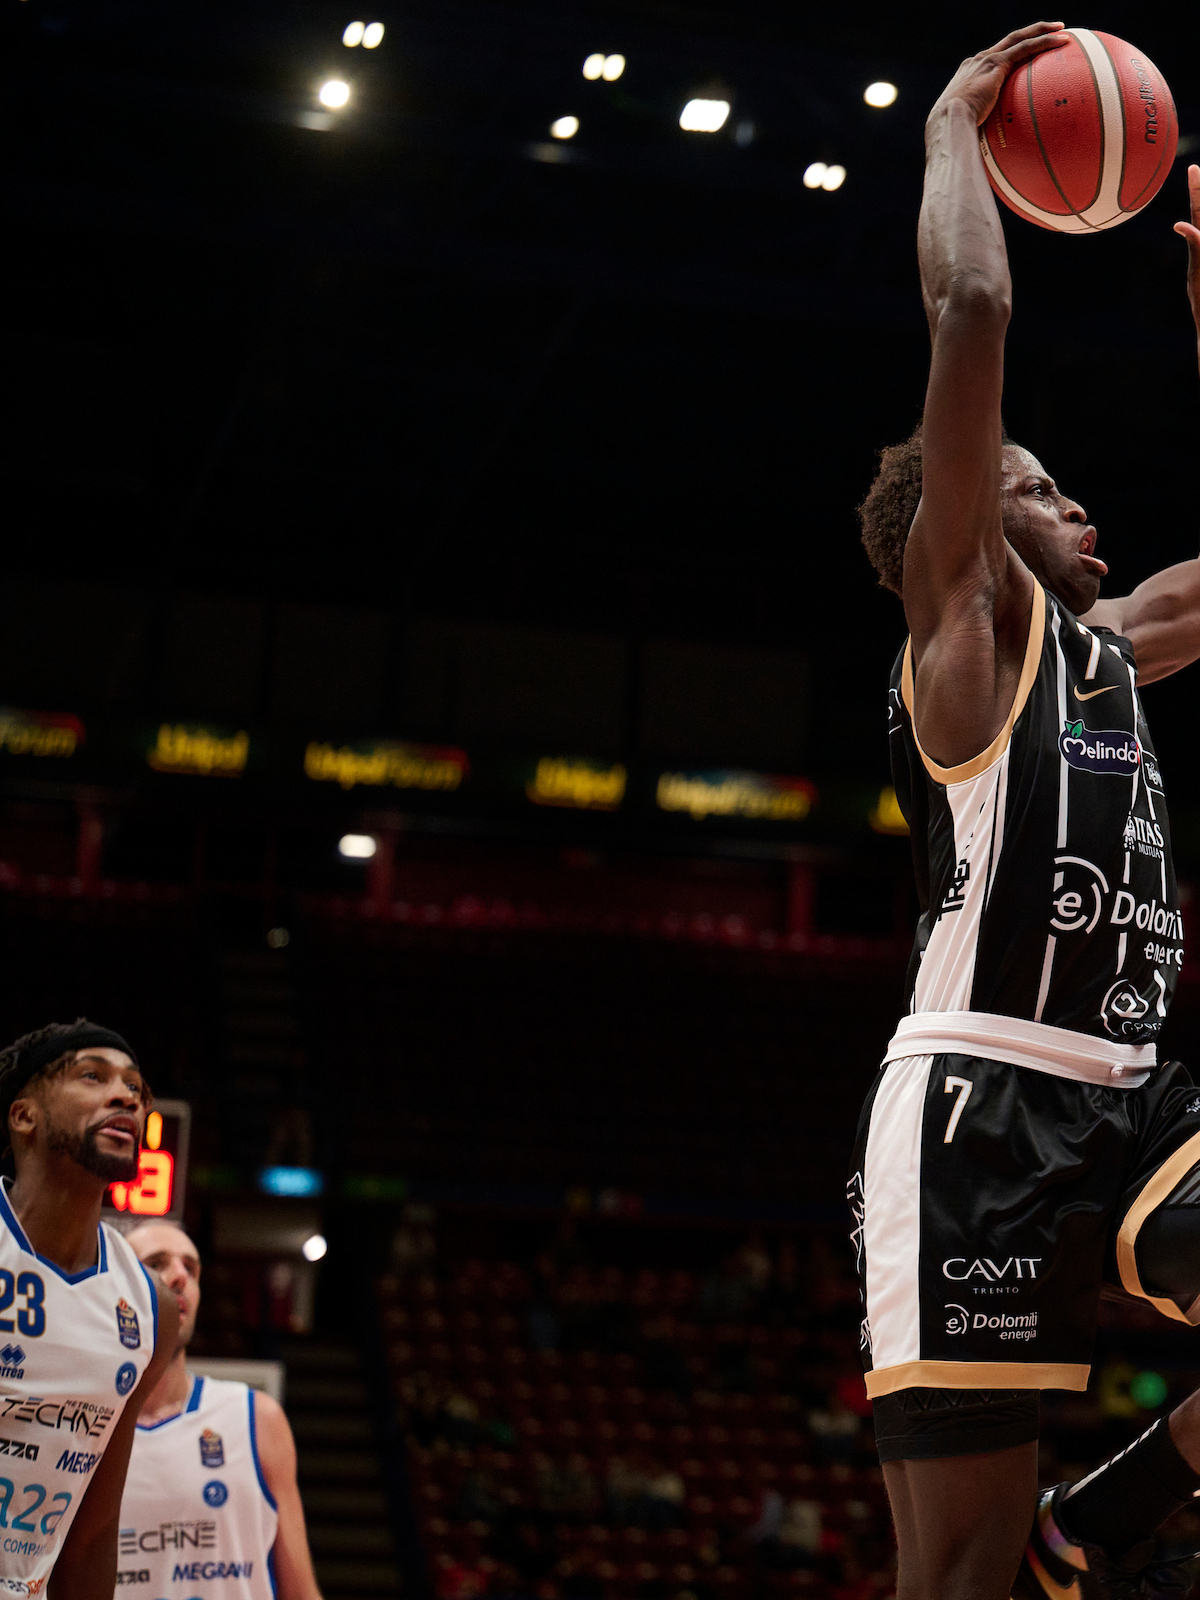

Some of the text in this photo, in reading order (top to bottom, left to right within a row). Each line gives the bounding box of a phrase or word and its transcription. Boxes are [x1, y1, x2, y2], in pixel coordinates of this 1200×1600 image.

[1131, 59, 1158, 145] molten
[1076, 622, 1101, 680] 7
[1063, 737, 1138, 764] Melinda
[944, 1075, 973, 1143] 7
[942, 1257, 1042, 1281] CAVIT
[972, 1312, 1038, 1329] Dolomiti
[999, 1328, 1037, 1341] energia
[1, 1397, 112, 1437] TECHNE
